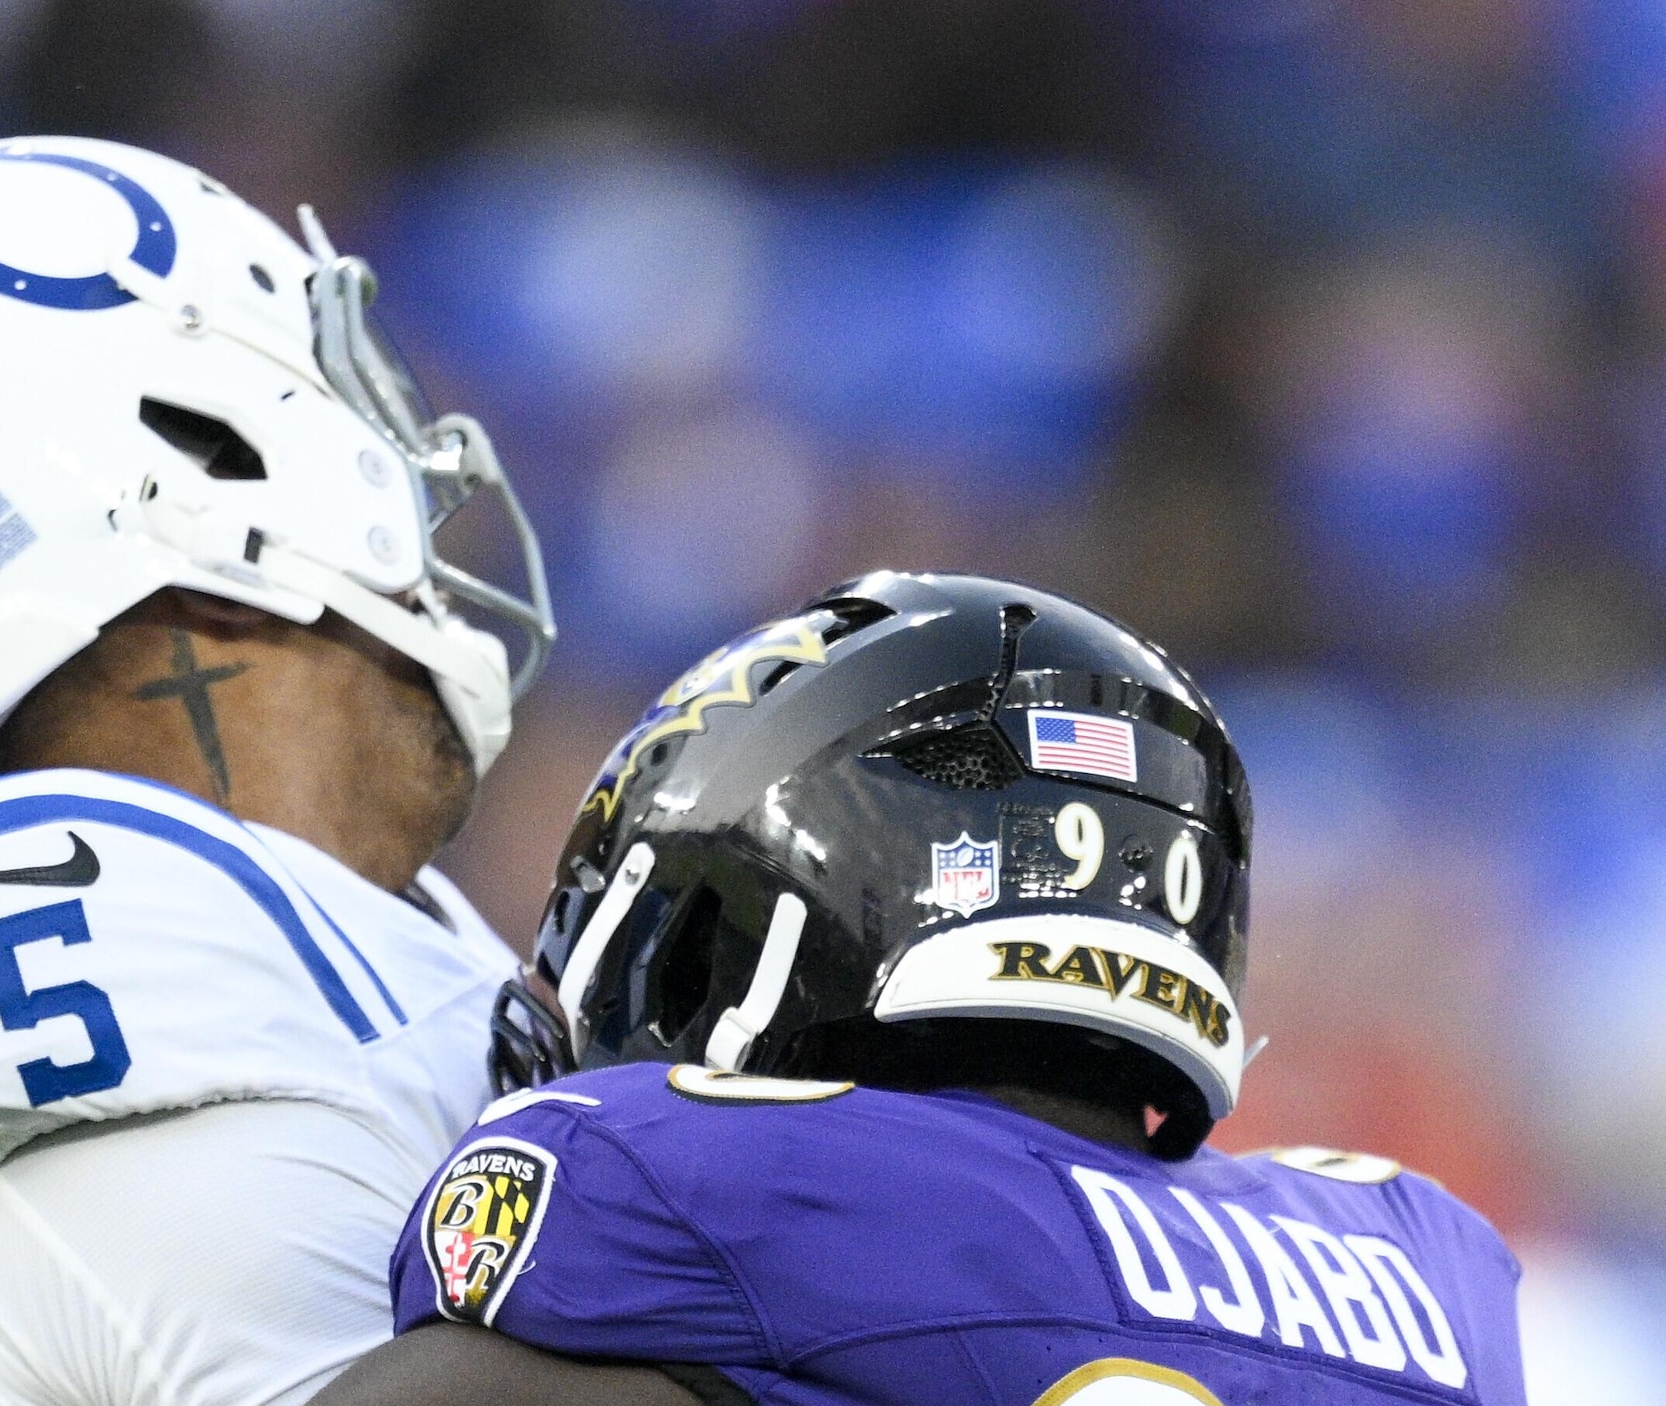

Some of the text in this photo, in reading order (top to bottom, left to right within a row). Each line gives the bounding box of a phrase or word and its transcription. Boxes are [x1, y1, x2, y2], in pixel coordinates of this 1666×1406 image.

[986, 939, 1231, 1049] RAVENS
[450, 1153, 536, 1182] RAVENS
[1070, 1164, 1468, 1390] OJABO
